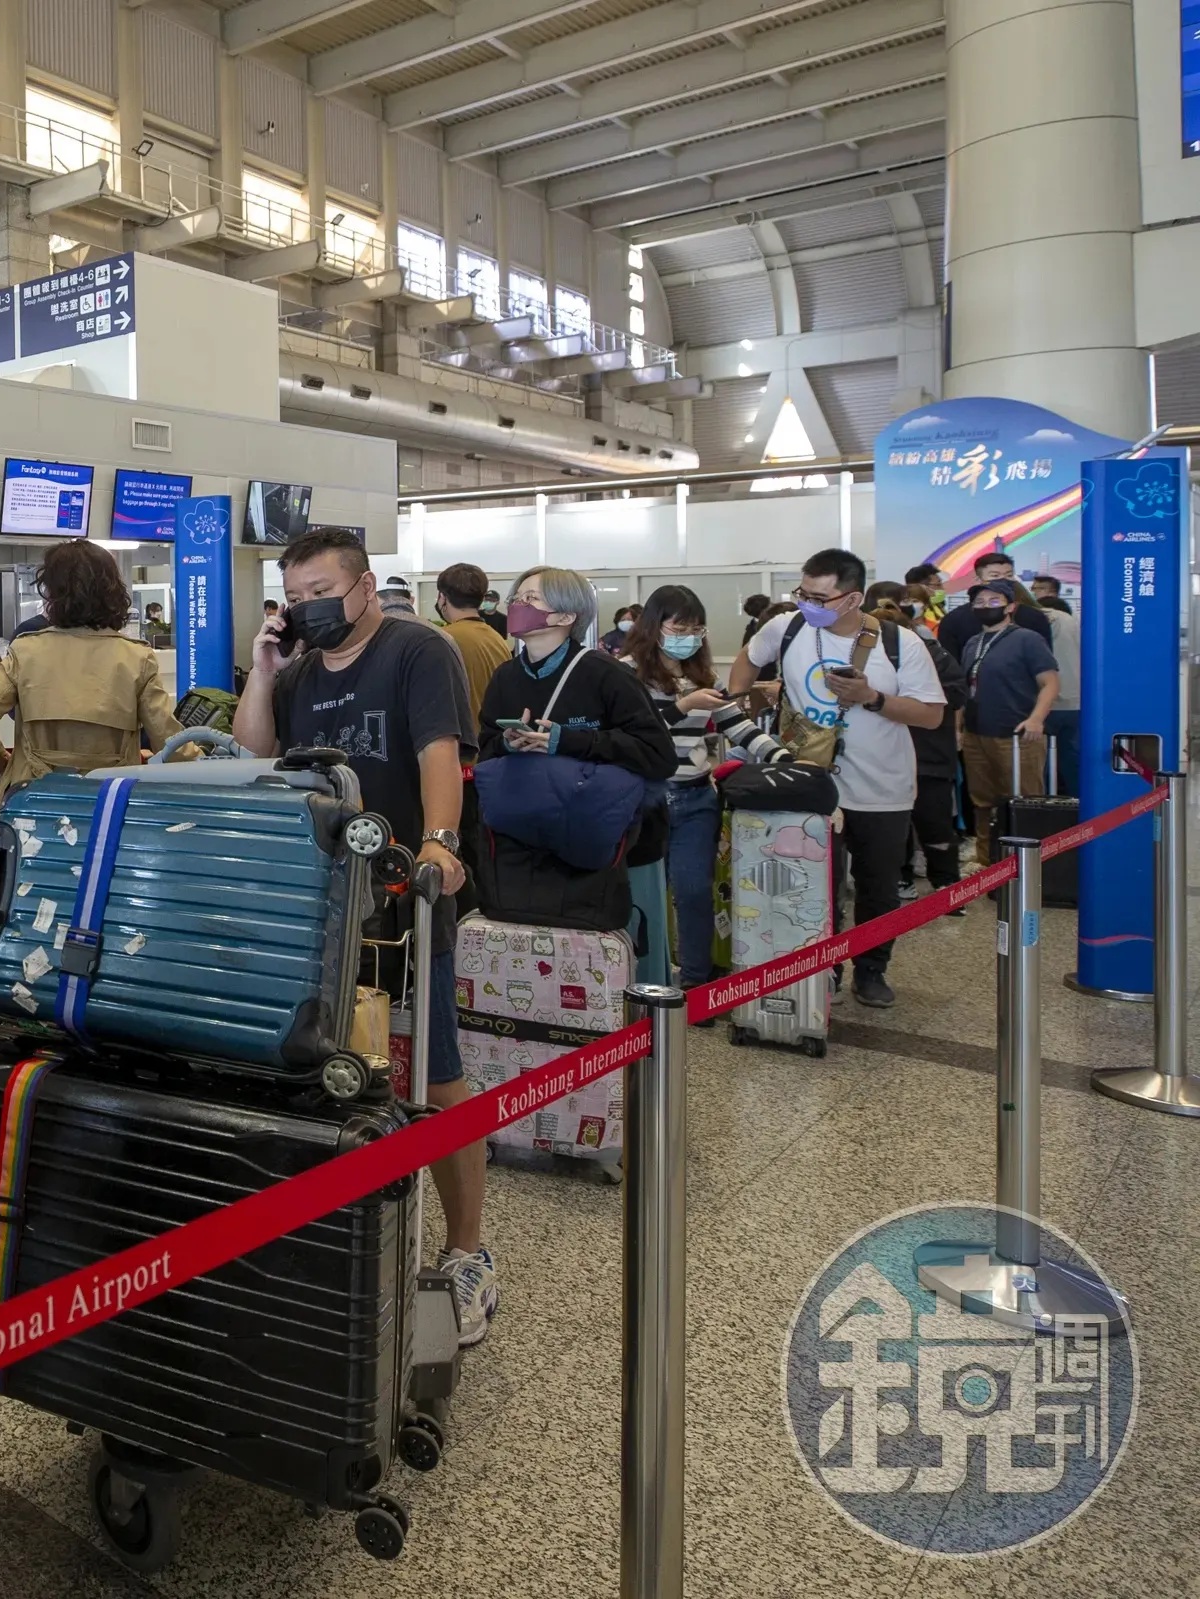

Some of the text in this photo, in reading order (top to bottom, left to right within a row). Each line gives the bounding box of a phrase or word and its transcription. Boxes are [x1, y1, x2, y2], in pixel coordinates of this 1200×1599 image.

[24, 298, 36, 306] Group
[37, 293, 56, 303] Assembly
[77, 283, 94, 292] Counter
[55, 312, 79, 322] Restroom
[76, 318, 94, 332] 商店
[81, 332, 95, 340] Shop
[1121, 557, 1135, 634] Economy Class
[1138, 557, 1155, 597] 經濟艙
[197, 575, 207, 628] 請在此等候
[188, 629, 196, 646] Next
[189, 646, 197, 680] Available
[312, 703, 322, 712] THE
[322, 700, 337, 710] BEST
[949, 882, 979, 906] Kaohsiung
[980, 860, 1012, 891] International
[707, 939, 850, 1010] Kaohsiung International Airport
[497, 1029, 654, 1123] Kaohsiung Internationa
[66, 1250, 172, 1324] Airport
